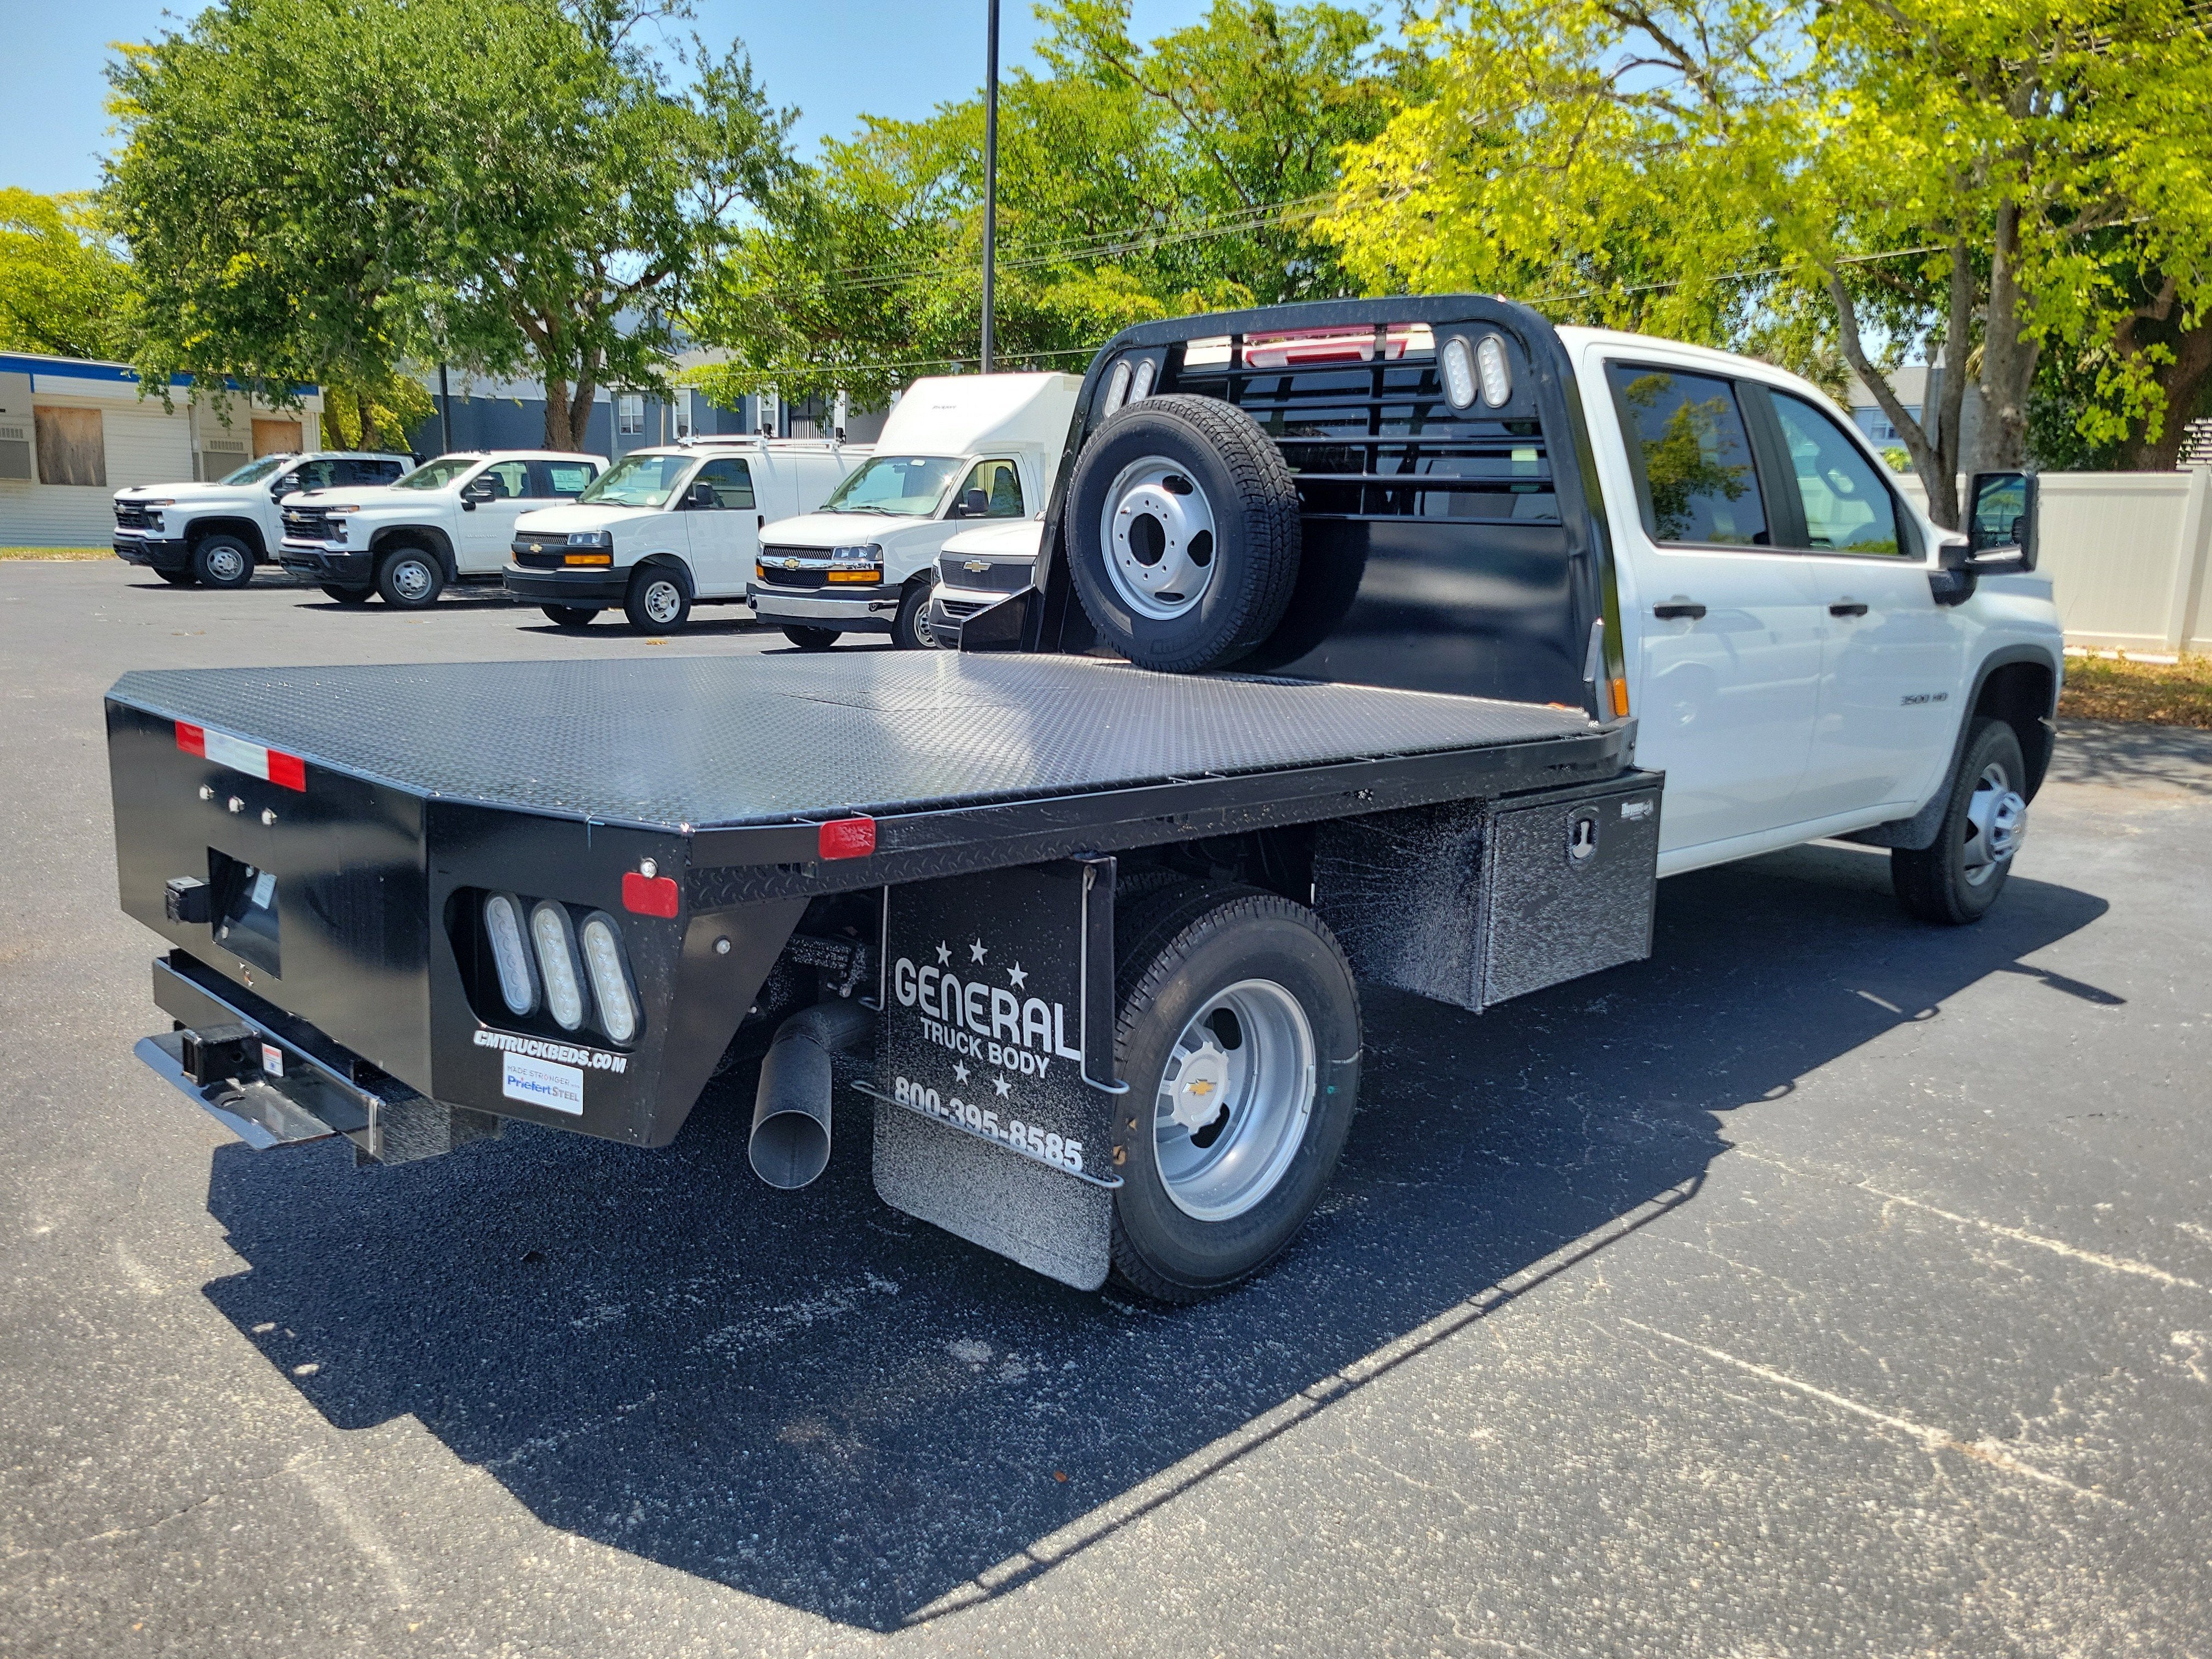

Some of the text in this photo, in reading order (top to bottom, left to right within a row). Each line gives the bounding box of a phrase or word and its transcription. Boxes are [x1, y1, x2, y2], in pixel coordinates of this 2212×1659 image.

[1901, 694, 1929, 705] 3500
[895, 957, 1081, 1062] GENERAL
[473, 1030, 628, 1074] CMTRUCKBEDS.COM
[920, 1017, 1050, 1079] TRUCK BODY
[507, 1065, 528, 1075] MADE
[529, 1070, 570, 1086] STRONGER
[895, 1076, 1083, 1172] 800-395-8585
